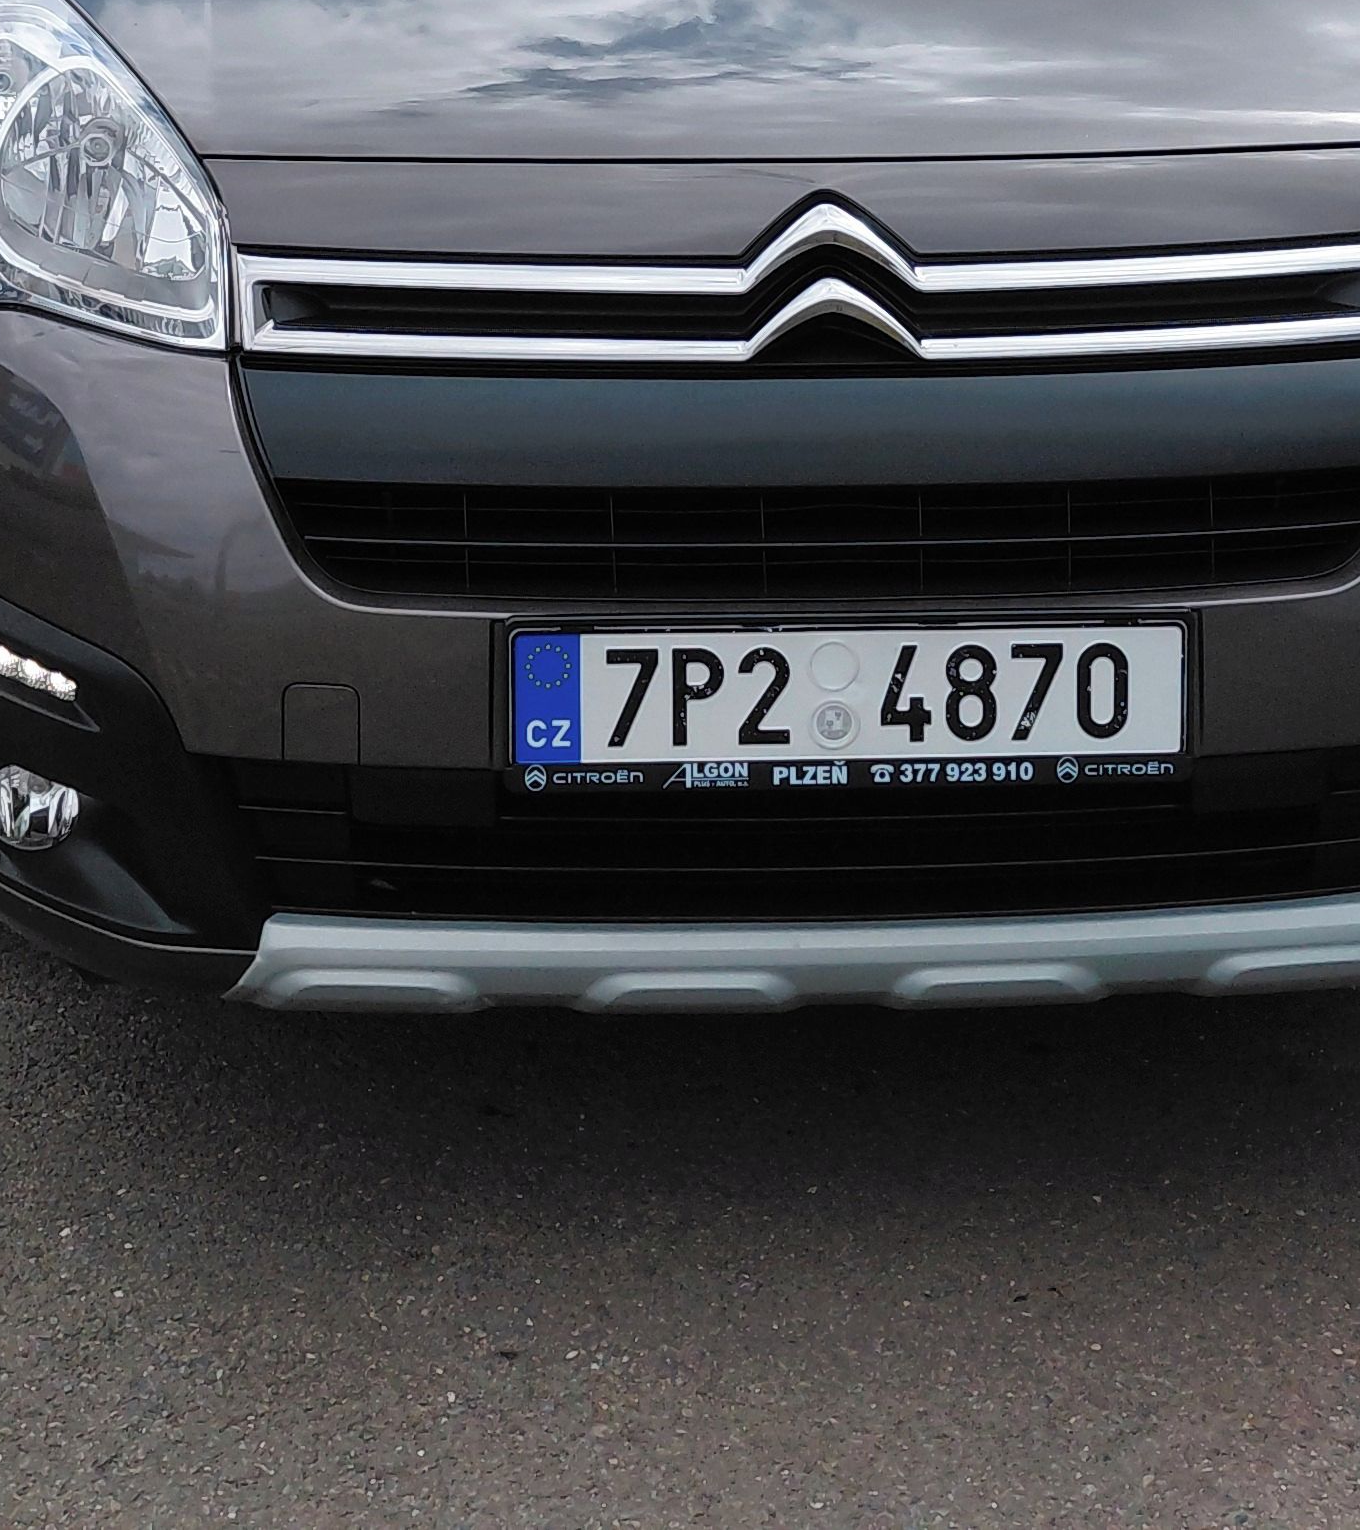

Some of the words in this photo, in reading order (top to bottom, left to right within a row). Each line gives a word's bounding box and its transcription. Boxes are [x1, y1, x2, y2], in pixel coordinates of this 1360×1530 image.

[606, 646, 791, 748] 7P2
[880, 642, 1129, 743] 4870
[526, 719, 572, 748] CZ
[662, 762, 749, 789] ALGON
[773, 760, 848, 786] PLZEŇ
[899, 763, 941, 783] 377
[946, 763, 987, 782] 923
[992, 762, 1034, 781] 910
